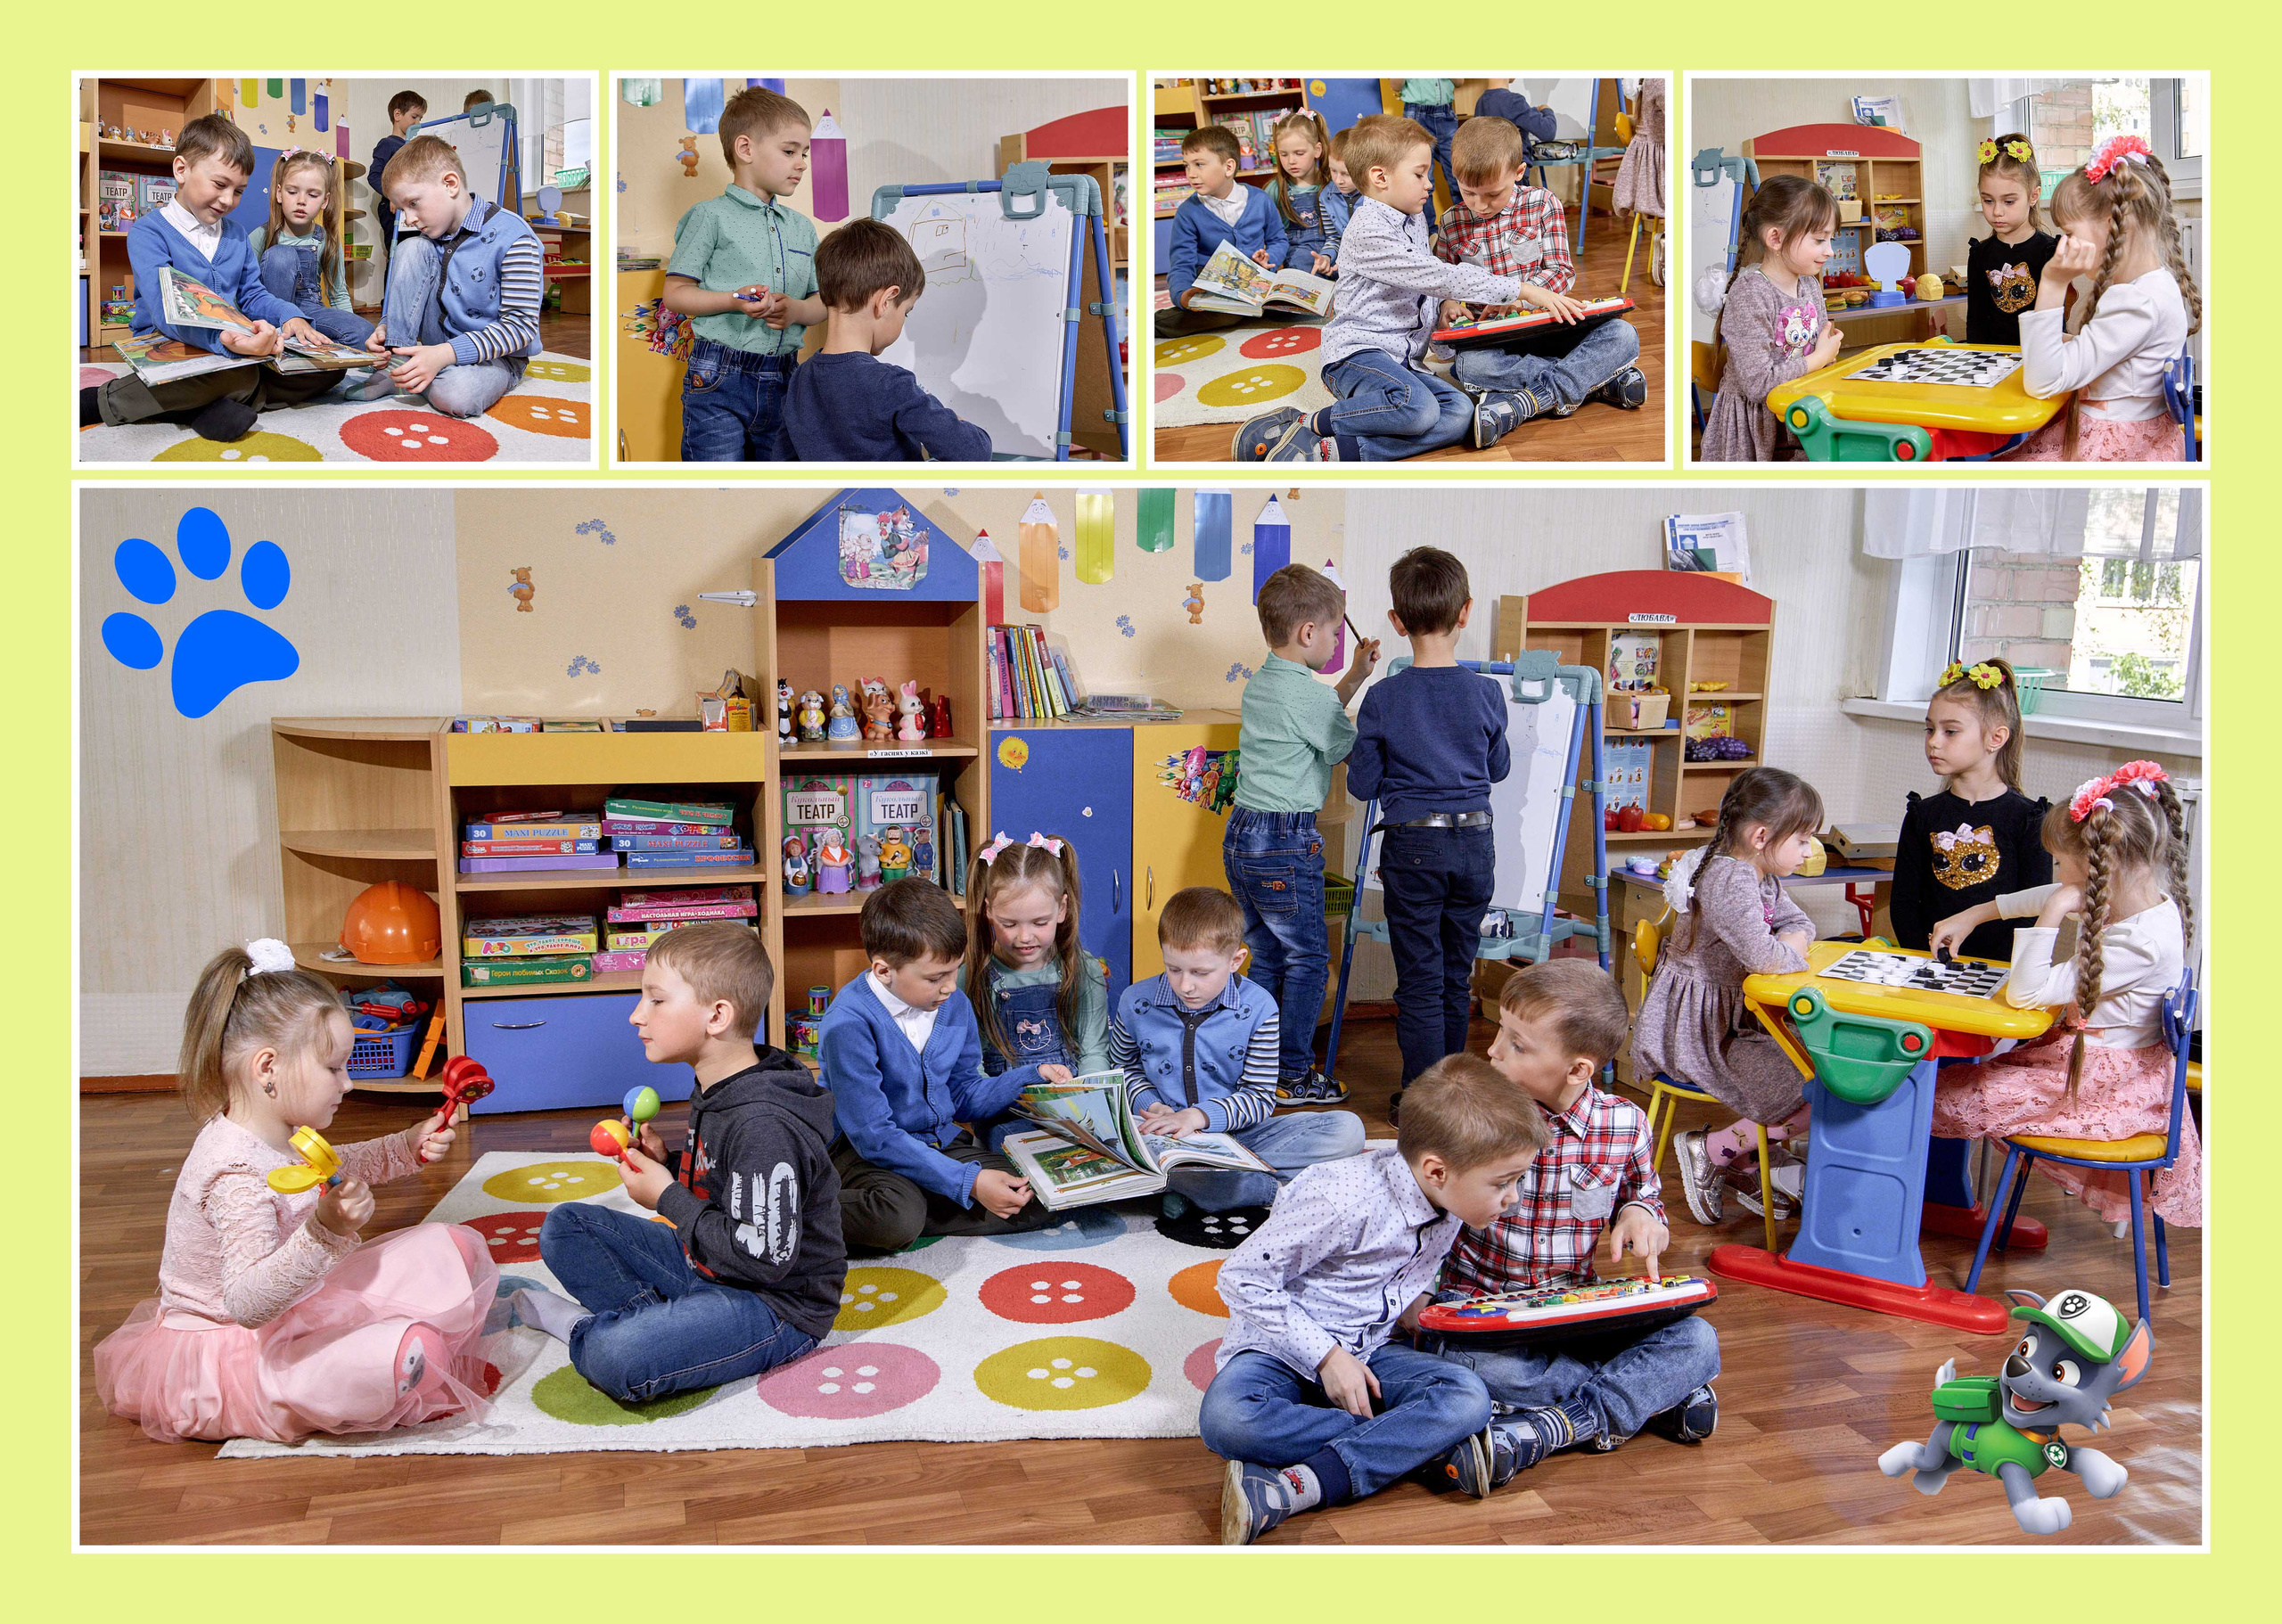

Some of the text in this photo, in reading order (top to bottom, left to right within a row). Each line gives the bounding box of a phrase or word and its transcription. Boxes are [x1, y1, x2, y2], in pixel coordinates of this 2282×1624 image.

[105, 187, 127, 196] ТЕАТР
[152, 192, 172, 201] ТЕАТР
[1630, 613, 1674, 622] «ЛЮБАВА»
[679, 808, 694, 816] ЧТО
[797, 804, 835, 820] ТЕАТР
[881, 803, 918, 819] ТЕАТР
[473, 829, 487, 838] 30
[504, 828, 569, 838] MAXI PUZZLE
[619, 840, 631, 848] 30
[647, 840, 709, 848] MAXI PUZZLE
[694, 854, 751, 863] ПРОФЕССИИ
[692, 892, 706, 901] 24
[556, 937, 581, 945] ХОРОШО
[564, 942, 585, 951] ПЛОХО
[491, 969, 512, 977] Герои
[513, 968, 545, 977] любимых
